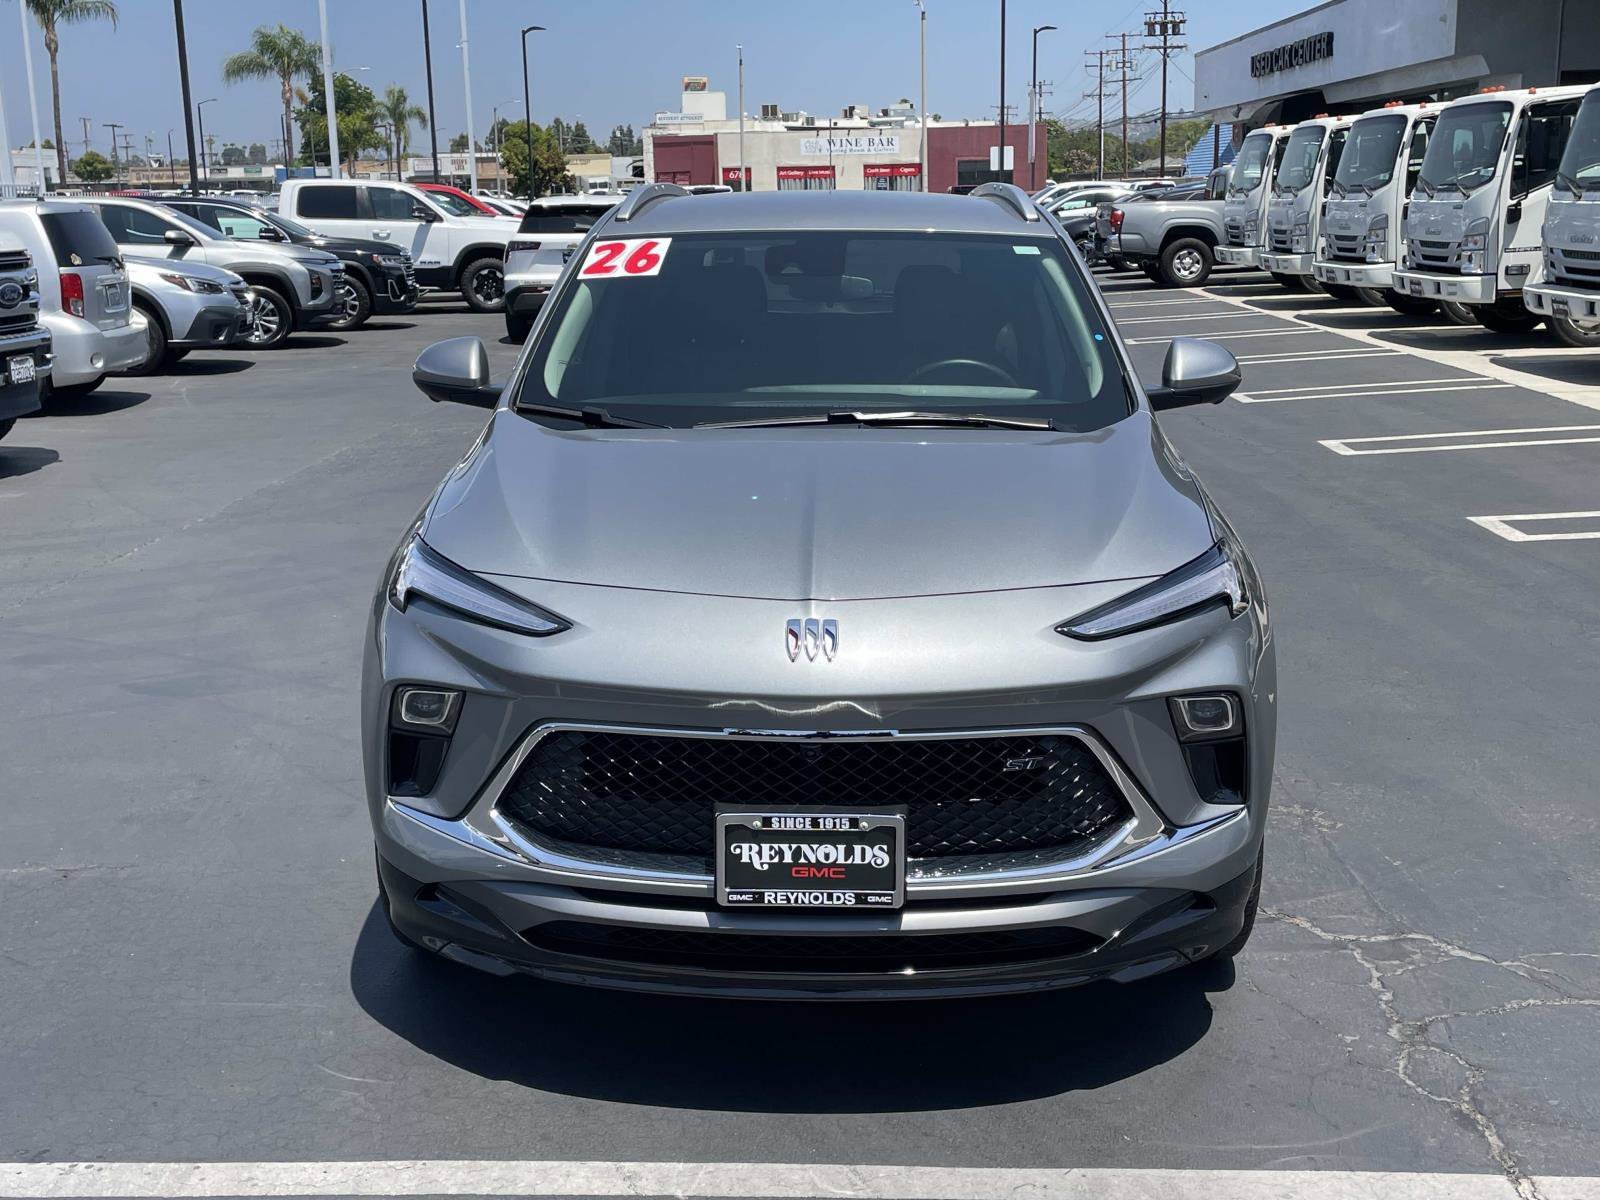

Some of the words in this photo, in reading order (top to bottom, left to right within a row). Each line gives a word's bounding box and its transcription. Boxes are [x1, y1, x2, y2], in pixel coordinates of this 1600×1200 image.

[1251, 51, 1273, 78] USED
[1273, 44, 1292, 72] CAR
[1292, 32, 1334, 67] CENTER
[827, 138, 863, 148] WINE
[868, 137, 896, 147] BAR
[583, 240, 661, 275] 26
[771, 817, 812, 829] SINCE
[817, 817, 850, 830] 1915
[730, 843, 890, 871] REYNOLDS
[791, 867, 846, 878] GMC
[764, 892, 856, 905] REYNOLDS
[867, 895, 892, 903] GMC
